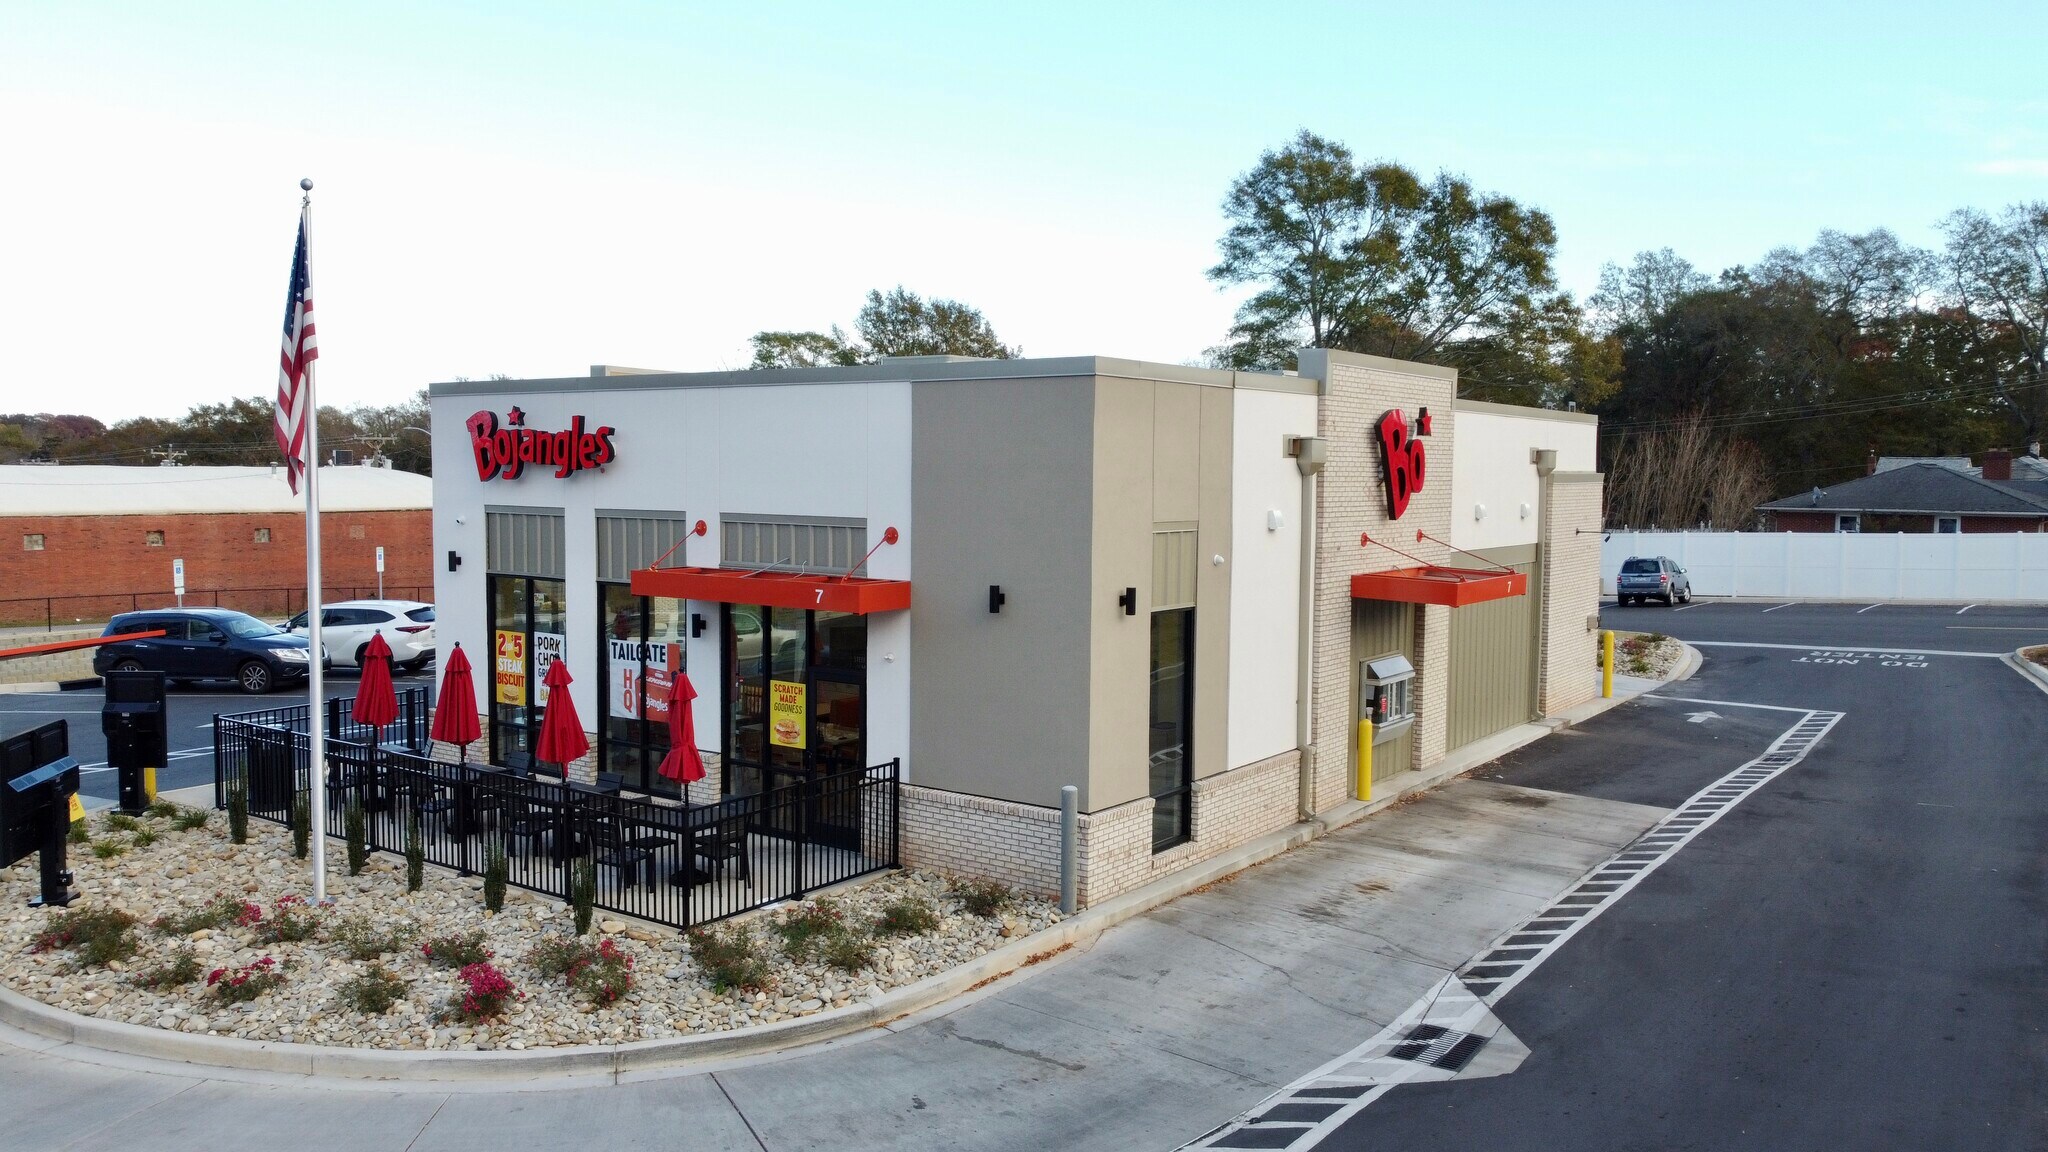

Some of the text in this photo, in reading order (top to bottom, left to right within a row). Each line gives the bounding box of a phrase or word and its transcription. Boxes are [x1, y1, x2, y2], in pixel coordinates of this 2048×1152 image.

[466, 407, 615, 482] Bojangles
[1374, 409, 1426, 520] Bo
[815, 589, 823, 604] 7
[498, 633, 507, 657] 2
[537, 636, 561, 653] PORK
[1792, 657, 1929, 668] DO NOT
[1810, 651, 1925, 661] ENTER
[498, 657, 523, 673] STEAK
[497, 672, 525, 688] BISCUIT
[773, 683, 803, 695] SCRATCH
[779, 693, 797, 704] MADE
[774, 702, 803, 715] GOODNESS
